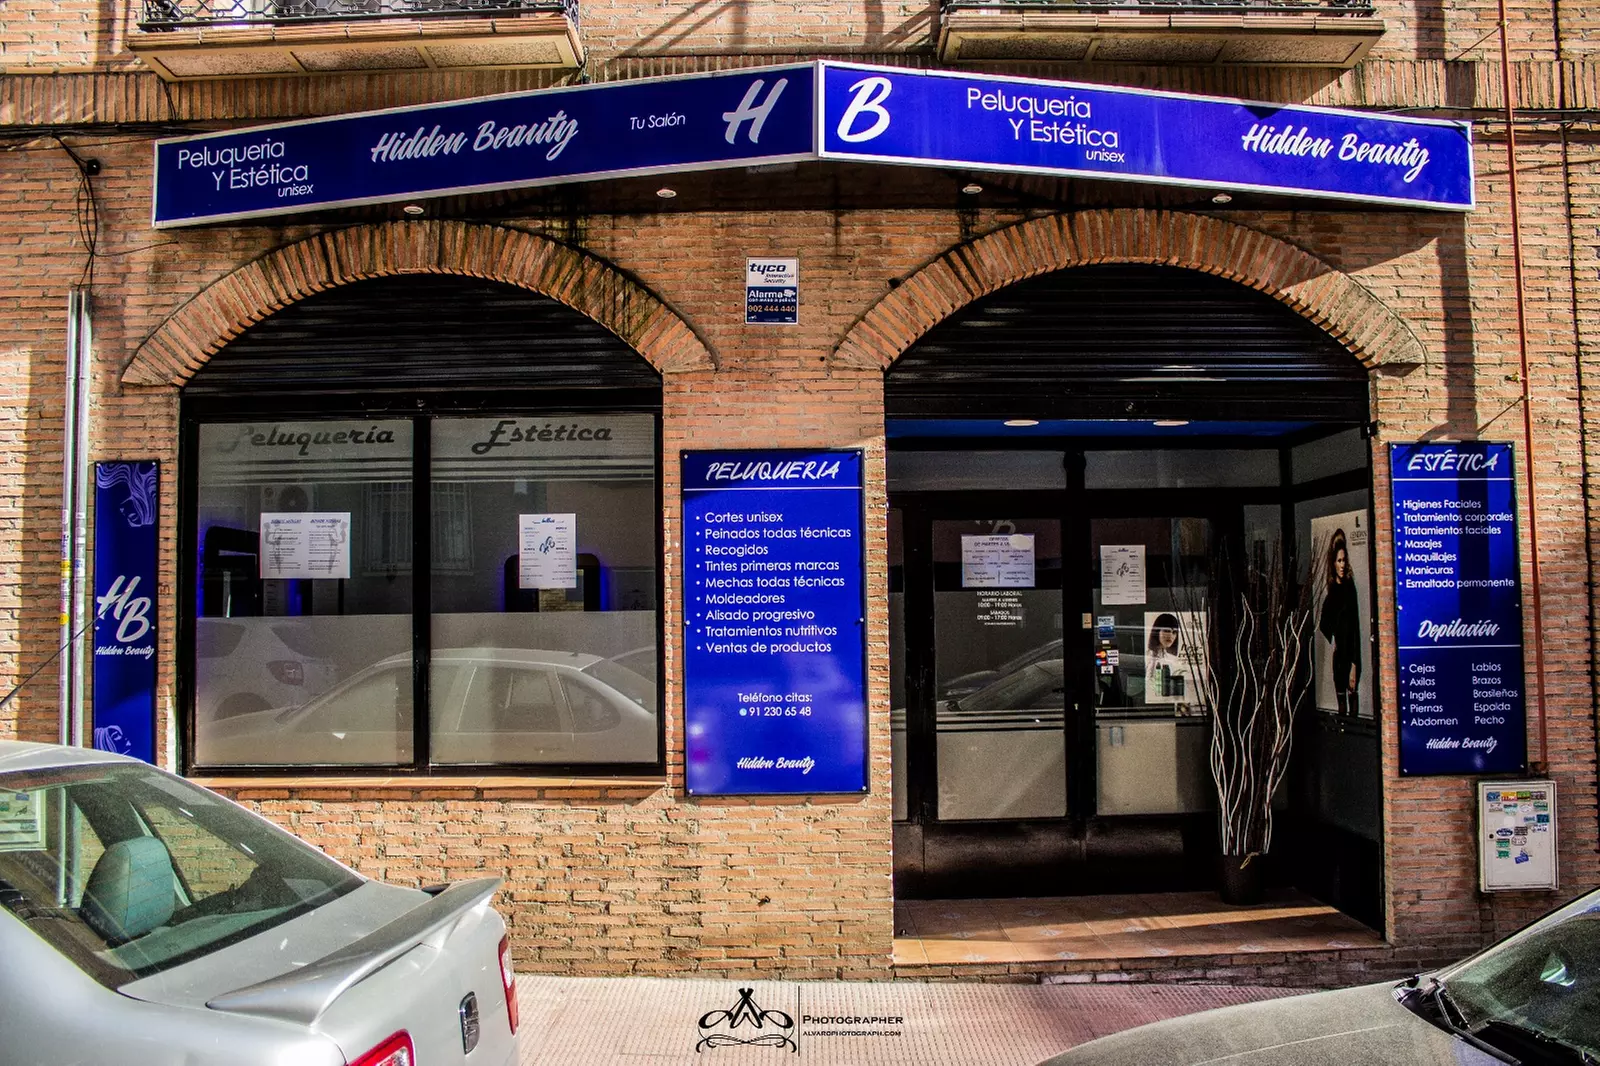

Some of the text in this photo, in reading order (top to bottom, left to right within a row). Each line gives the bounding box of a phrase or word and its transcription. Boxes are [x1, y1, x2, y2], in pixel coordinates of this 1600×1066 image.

[838, 77, 892, 142] B
[967, 87, 1091, 121] Peluqueria
[722, 78, 788, 144] H
[630, 112, 685, 130] Tu Salón
[371, 110, 578, 163] Hidden Beauty
[1009, 118, 1118, 148] Y Estética
[178, 138, 285, 172] Peluqueria
[1086, 148, 1124, 163] unisex
[1242, 124, 1430, 183] Hidden Beauty
[212, 162, 308, 190] Y Estética
[278, 184, 313, 197] unisex
[750, 264, 786, 274] tyco
[471, 420, 613, 455] Estética
[1408, 449, 1498, 471] ESTÉTICA
[706, 461, 840, 480] PELUQUERIA
[1403, 500, 1481, 510] Higienes Faciales
[705, 512, 783, 523] Cortes unisex
[1404, 512, 1513, 522] Tratamientos corporales
[705, 527, 851, 539] Peinados todas técnicas
[1404, 526, 1501, 535] Tratamientos faciales
[706, 544, 768, 557] Recogidos
[1405, 539, 1442, 550] Masajes
[1405, 552, 1456, 563] Maquillajes
[705, 560, 839, 573] Tintes primeras marcas
[1406, 566, 1454, 575] Manicuras
[706, 576, 844, 588] Mechas todas técnicas
[1406, 578, 1514, 589] Esmaltado permanente
[706, 593, 785, 604] Moldeadores
[706, 609, 815, 622] Alisado progresivo
[706, 625, 837, 637] Tratamientos nutritivos
[1418, 618, 1500, 642] Depilación
[95, 645, 154, 660] Hidden Beauty
[706, 642, 831, 654] Ventas de productos
[1409, 664, 1435, 674] Cejas
[1472, 662, 1501, 671] Labios
[1410, 677, 1435, 686] Axilas
[1472, 676, 1501, 684] Brazos
[738, 692, 812, 702] Teléfono citas:
[1410, 691, 1436, 701] Ingles
[1473, 689, 1518, 698] Brasileñas
[749, 706, 811, 716] 91 230 65 48
[1410, 704, 1443, 713] Piernas
[1474, 702, 1510, 712] Espalda
[1410, 717, 1458, 726] Abdomen
[1475, 716, 1505, 724] Pecho
[1426, 736, 1497, 754] Hidden Beauty
[737, 756, 815, 774] Hidden Beauty
